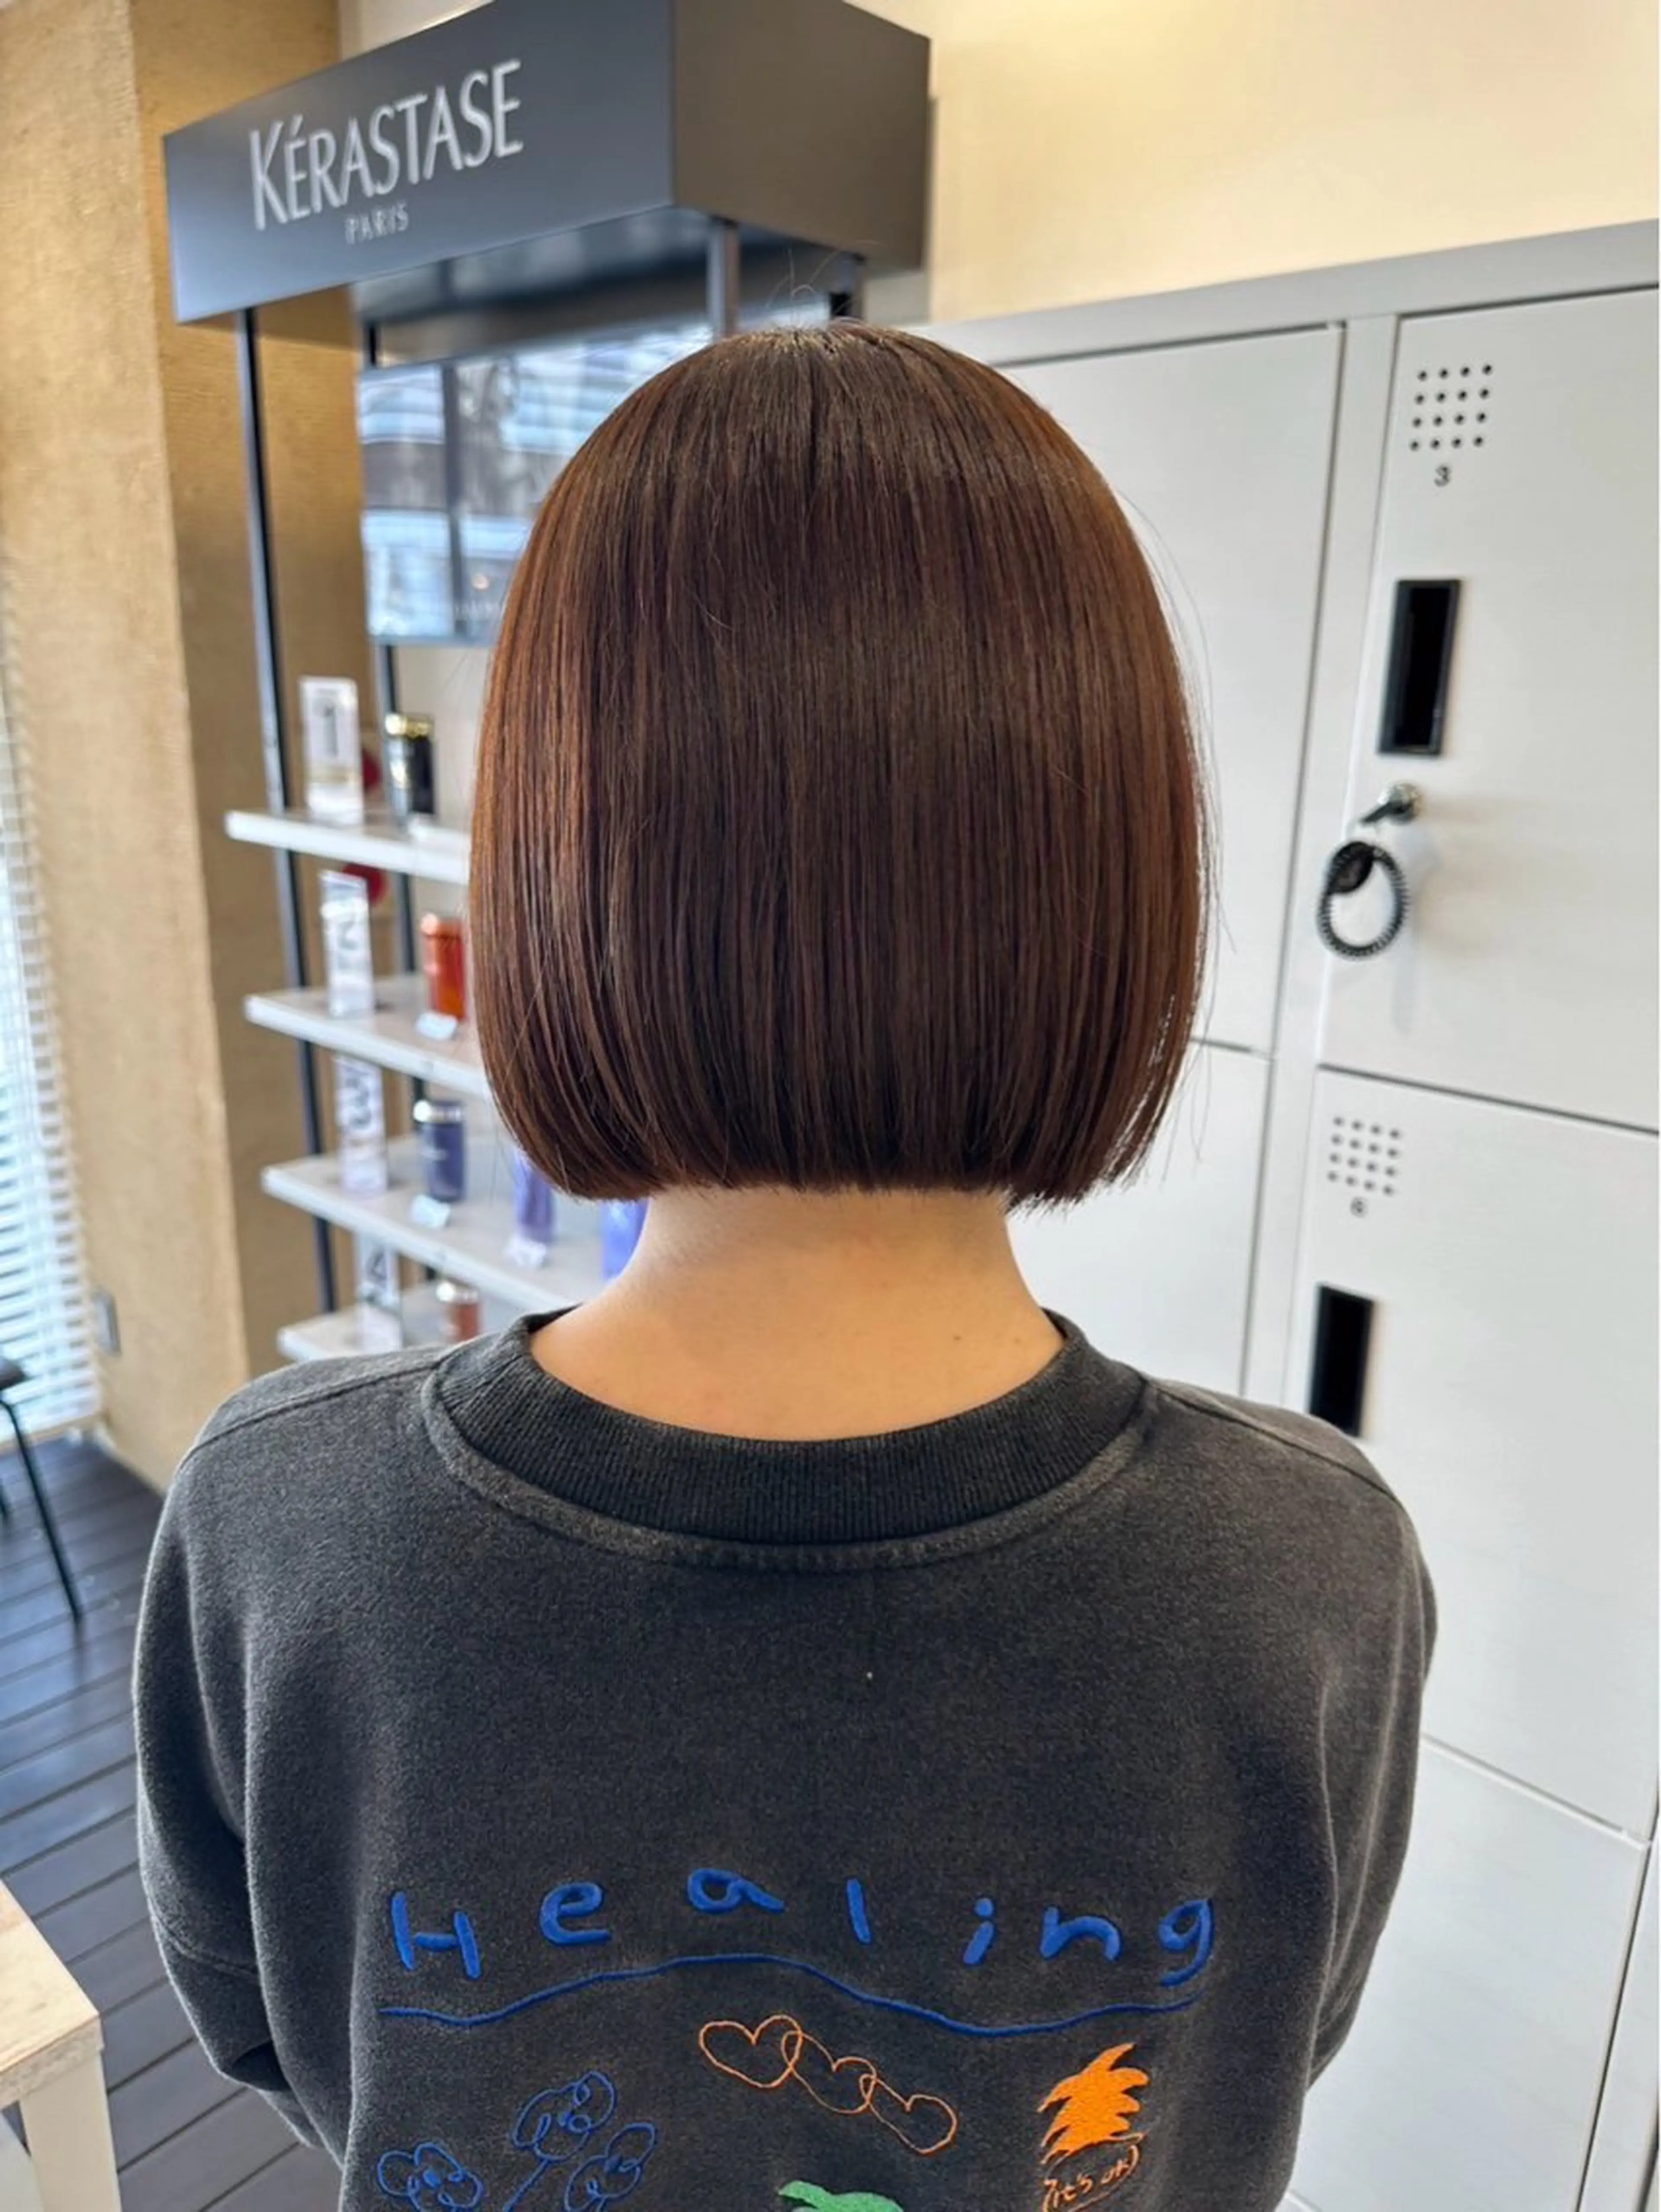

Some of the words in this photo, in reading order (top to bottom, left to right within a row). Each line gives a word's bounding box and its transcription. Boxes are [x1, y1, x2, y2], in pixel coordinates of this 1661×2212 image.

[250, 59, 523, 231] KÉRASTASE
[345, 200, 409, 244] PARIS
[1433, 464, 1451, 487] 3
[391, 1867, 1210, 1986] Healing
